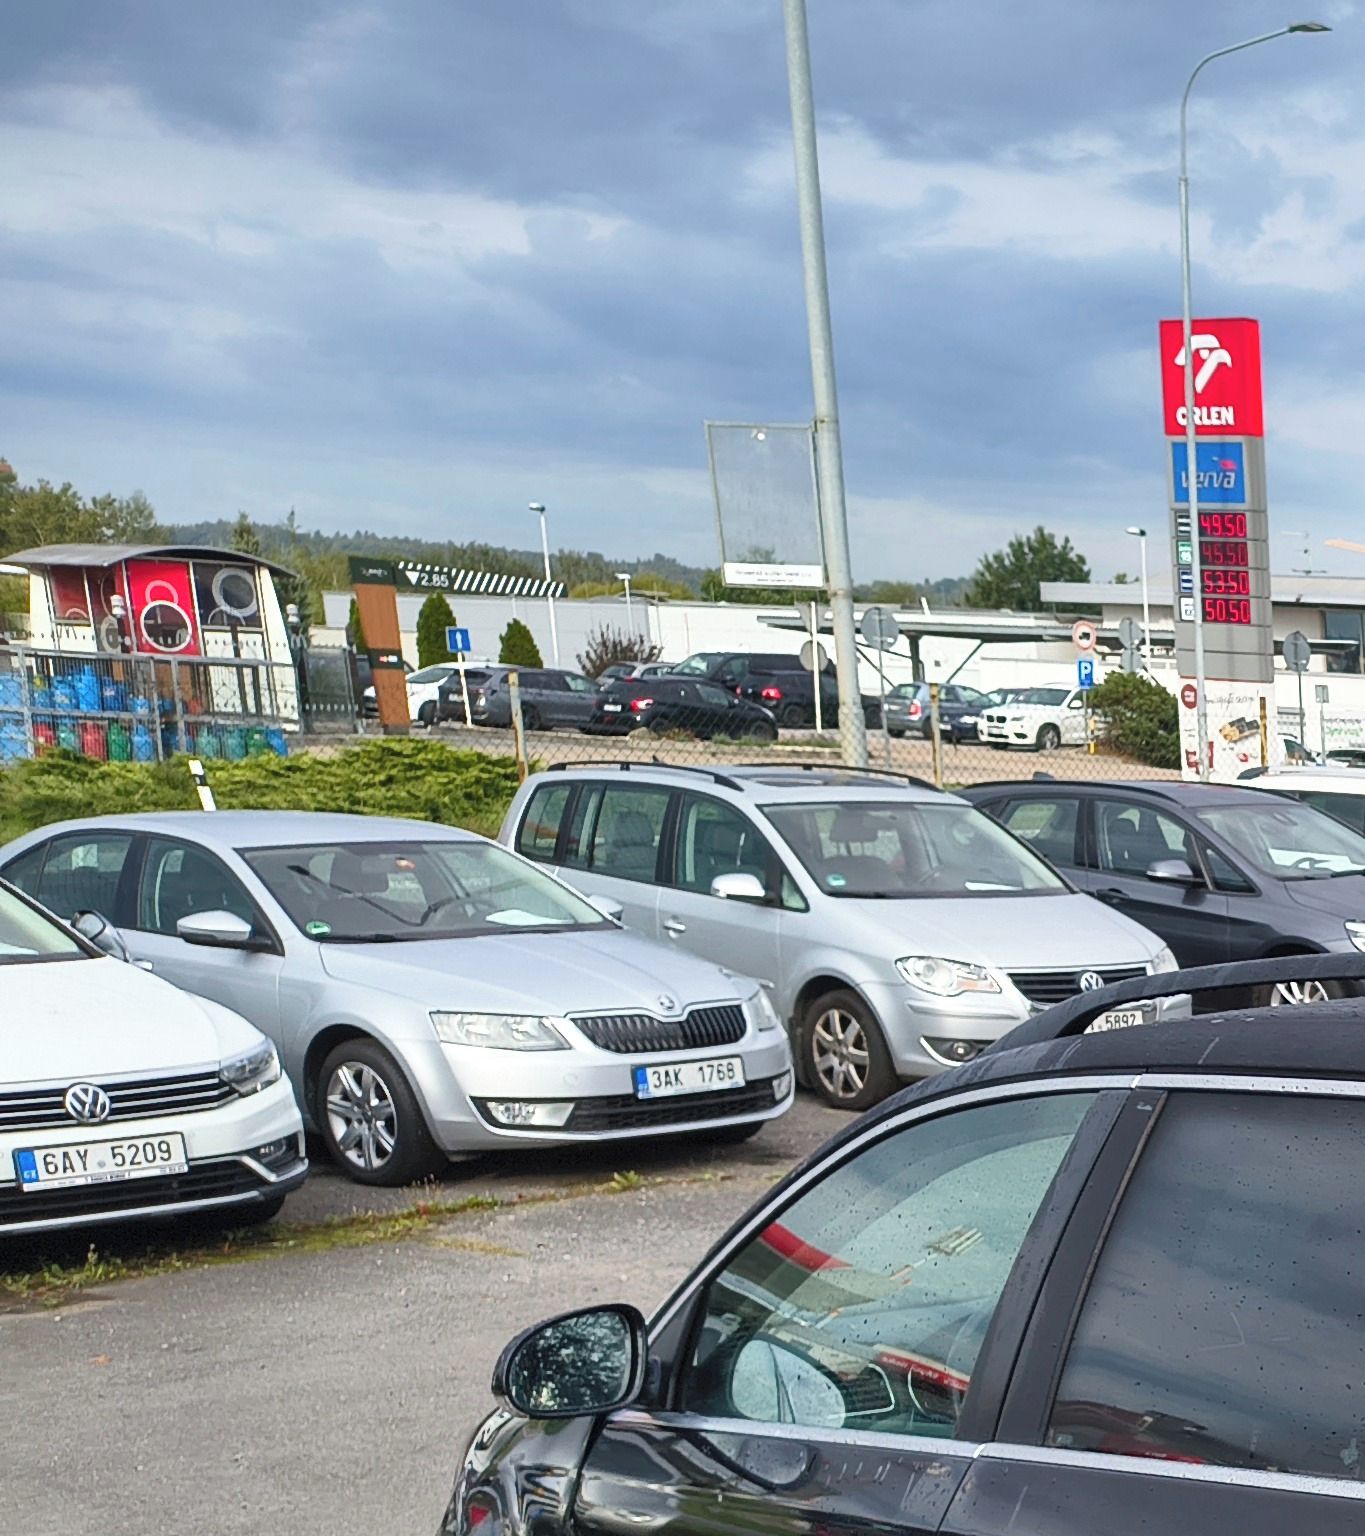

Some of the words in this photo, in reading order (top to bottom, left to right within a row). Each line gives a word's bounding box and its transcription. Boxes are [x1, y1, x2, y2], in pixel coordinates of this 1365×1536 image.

[652, 1067, 684, 1089] 3AK
[698, 1062, 736, 1083] 1768
[43, 1149, 89, 1175] 6AY
[110, 1140, 172, 1167] 5209
